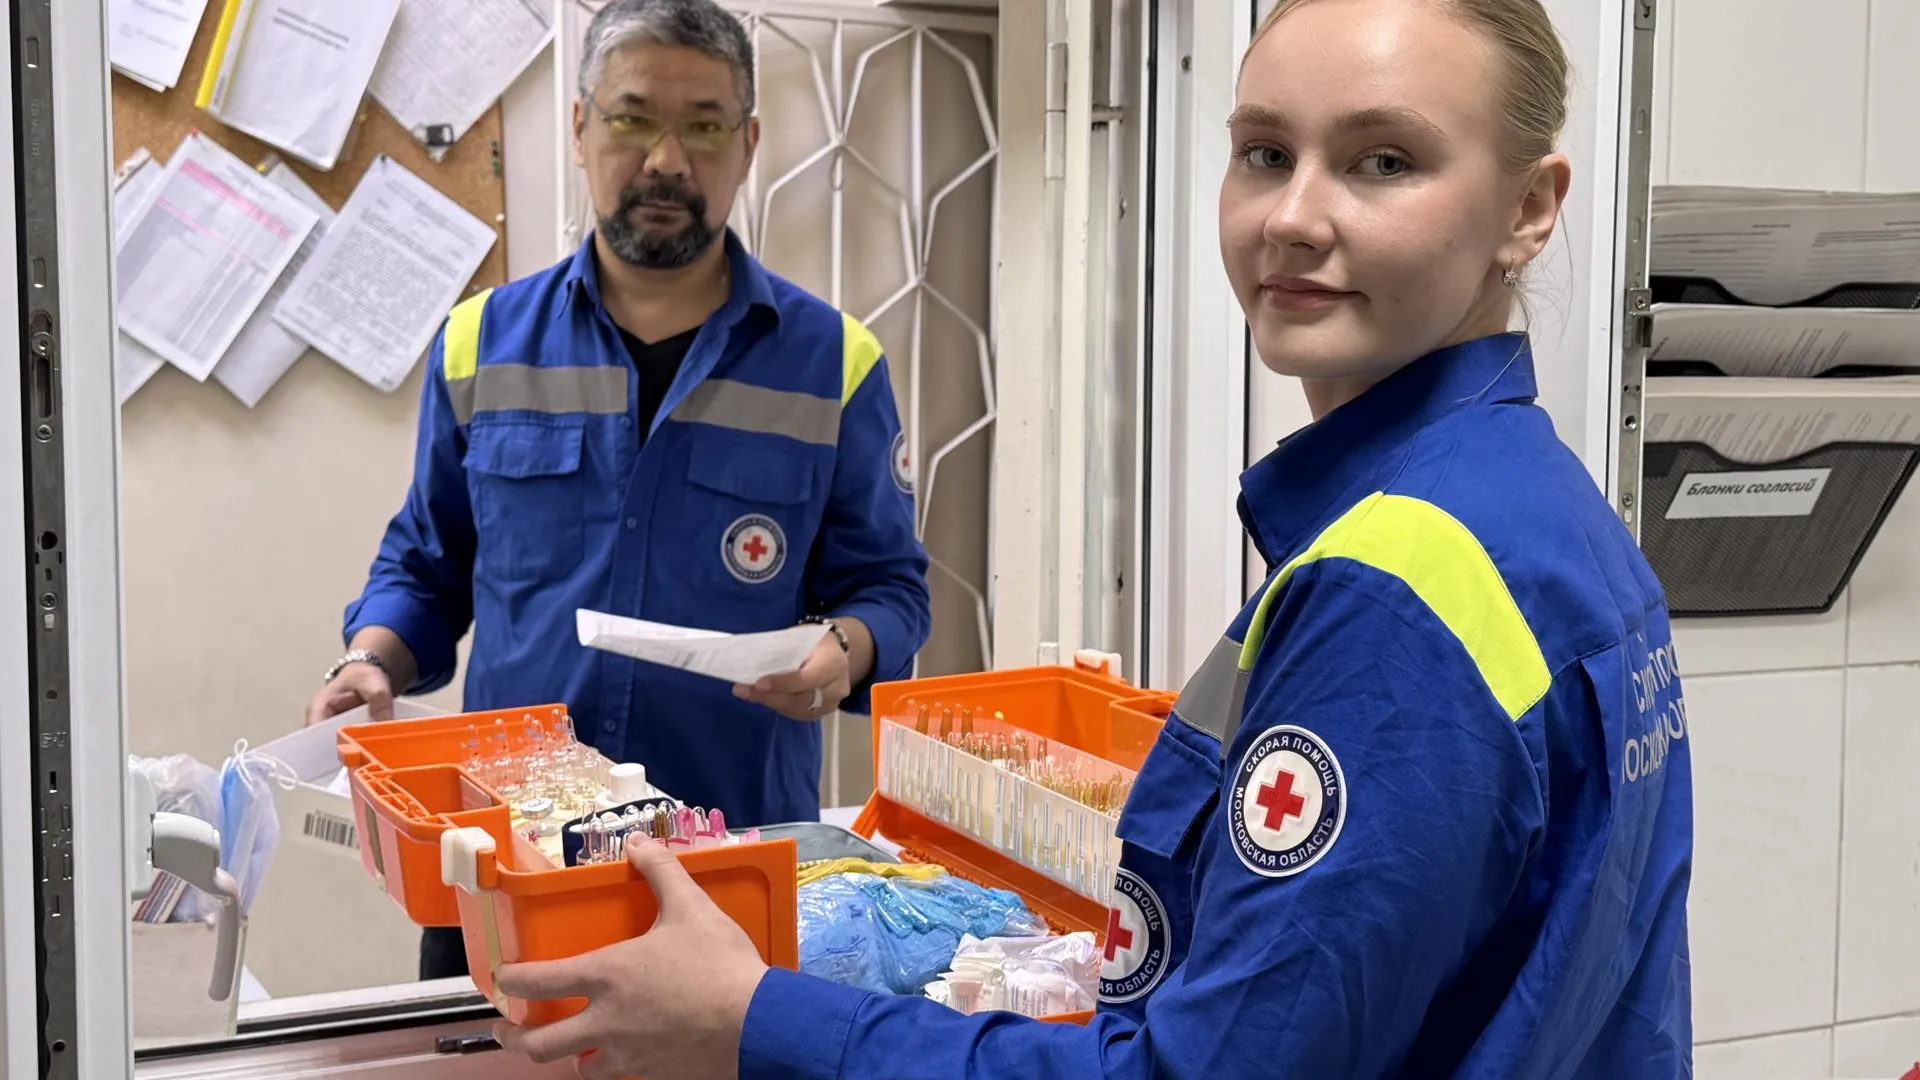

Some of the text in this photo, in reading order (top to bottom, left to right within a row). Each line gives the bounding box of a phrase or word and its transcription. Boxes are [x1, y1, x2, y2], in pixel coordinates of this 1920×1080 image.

[1686, 478, 1817, 496] Бланки согласий
[1245, 735, 1338, 797] СКОРАЯ ПОМОЩЬ
[1233, 786, 1334, 867] МОСКОВСКАЯ ОБЛАСТЬ
[1116, 949, 1161, 994] ОБЛАСТЬ
